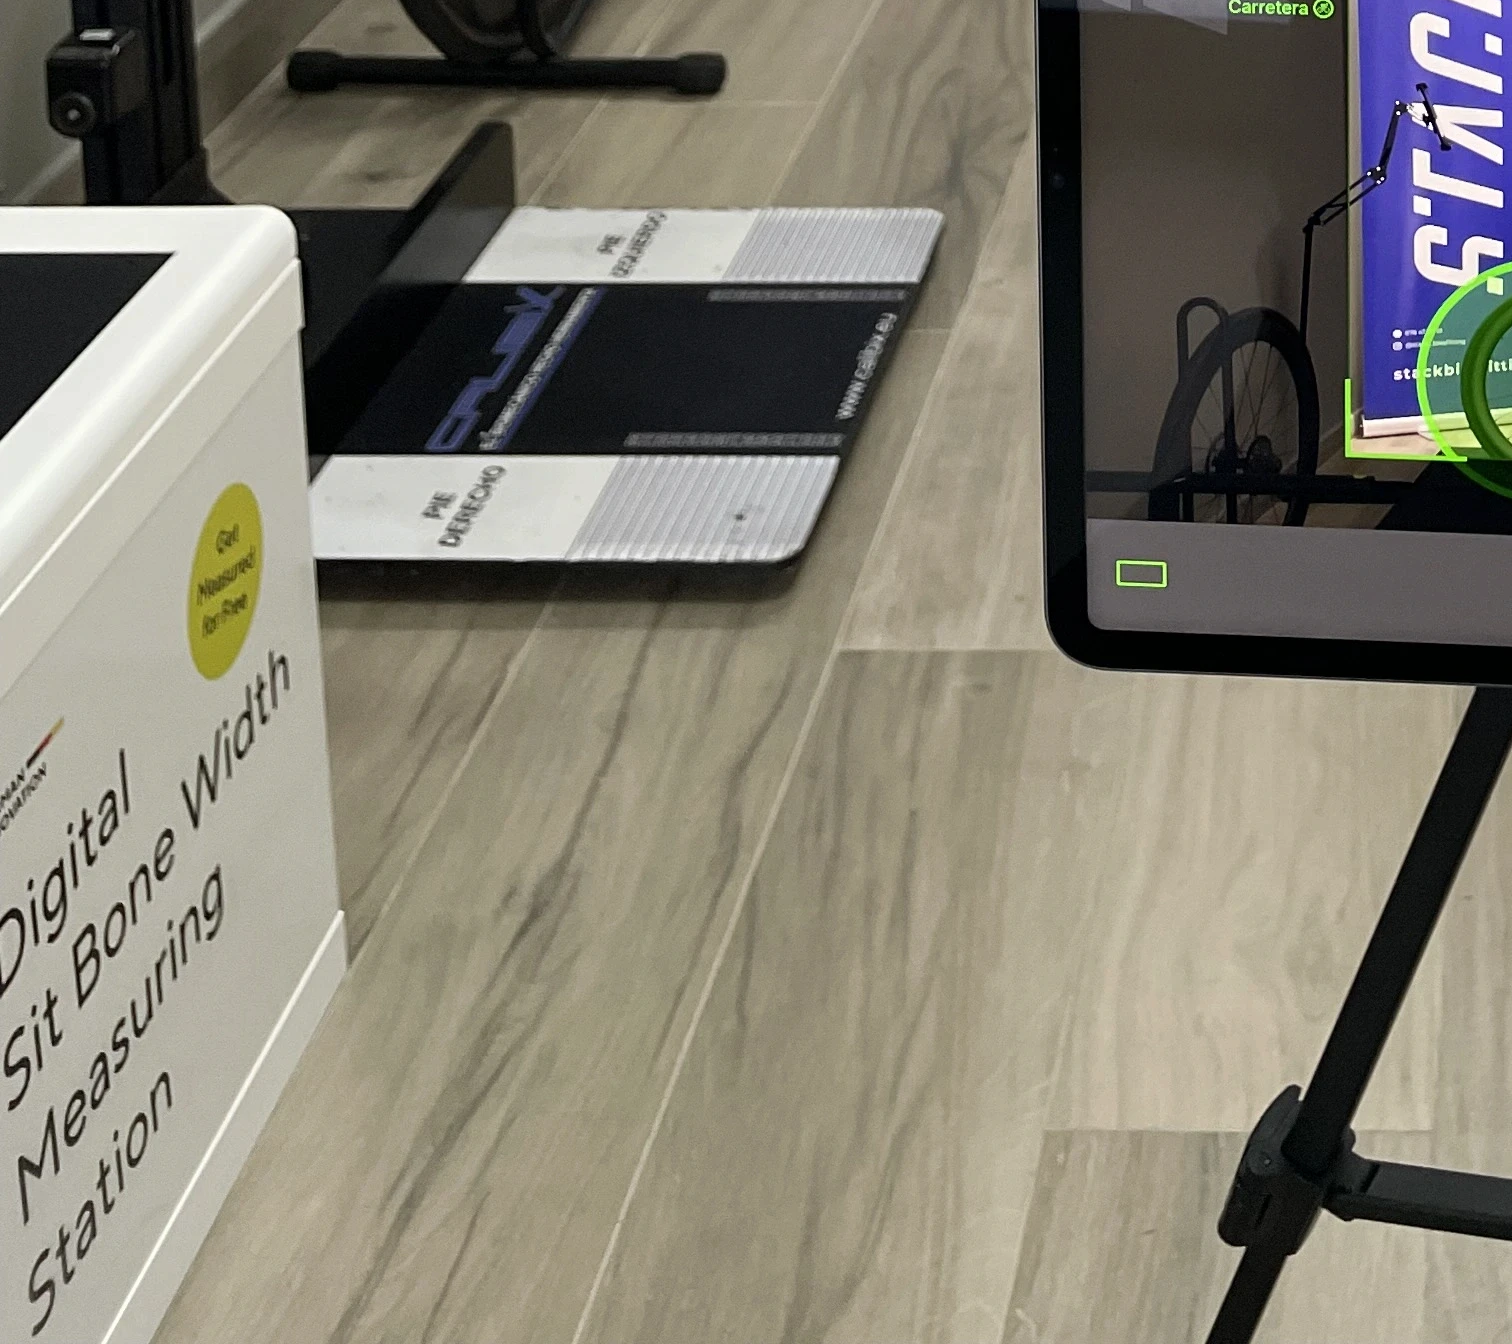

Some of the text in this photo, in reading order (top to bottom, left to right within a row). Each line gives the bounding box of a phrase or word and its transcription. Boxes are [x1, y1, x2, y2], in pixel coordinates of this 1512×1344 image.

[421, 491, 457, 520] PIE
[438, 465, 507, 547] DERECHO
[0, 748, 129, 999] Digital
[3, 648, 291, 1112] Sit Bone Width
[17, 863, 225, 1227] Measuring
[28, 1071, 173, 1338] Station
